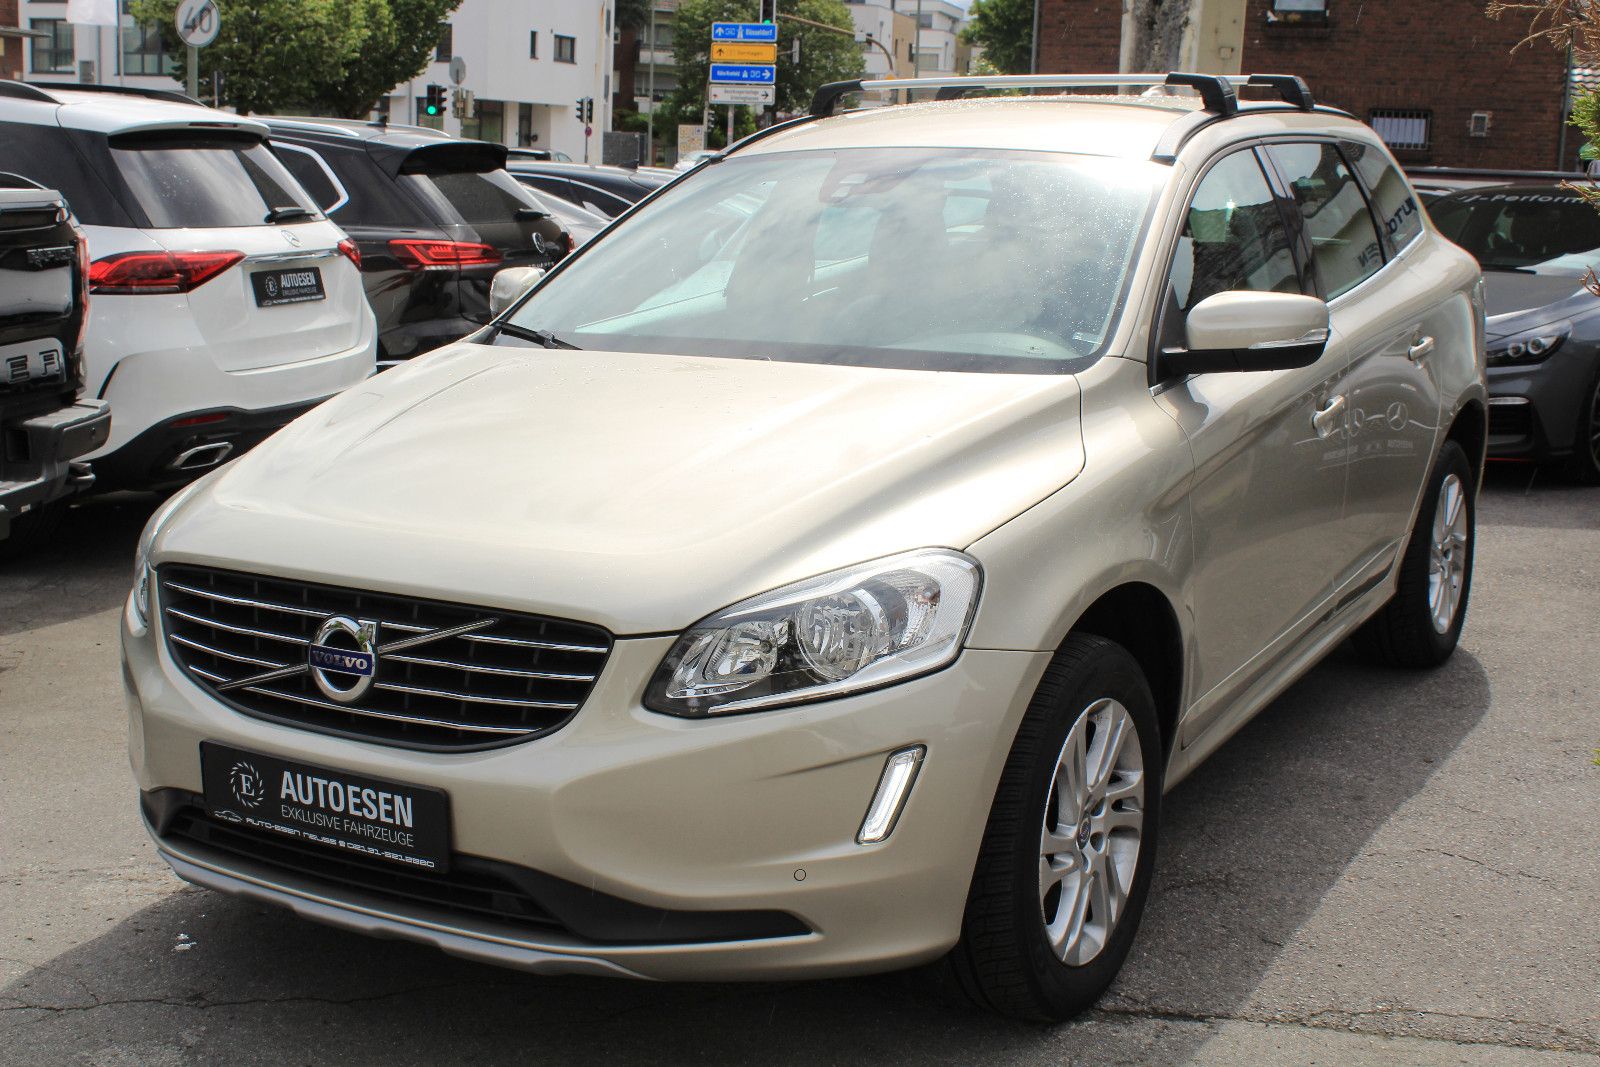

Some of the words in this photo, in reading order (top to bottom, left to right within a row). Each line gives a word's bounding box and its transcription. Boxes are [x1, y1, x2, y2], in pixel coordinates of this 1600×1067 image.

[183, 6, 212, 33] 40
[280, 272, 316, 288] AUTOESEN
[312, 650, 368, 670] VOLVO
[240, 774, 255, 796] E
[281, 804, 341, 830] EXKLUSIVE
[344, 819, 414, 847] FAHRZEUGE
